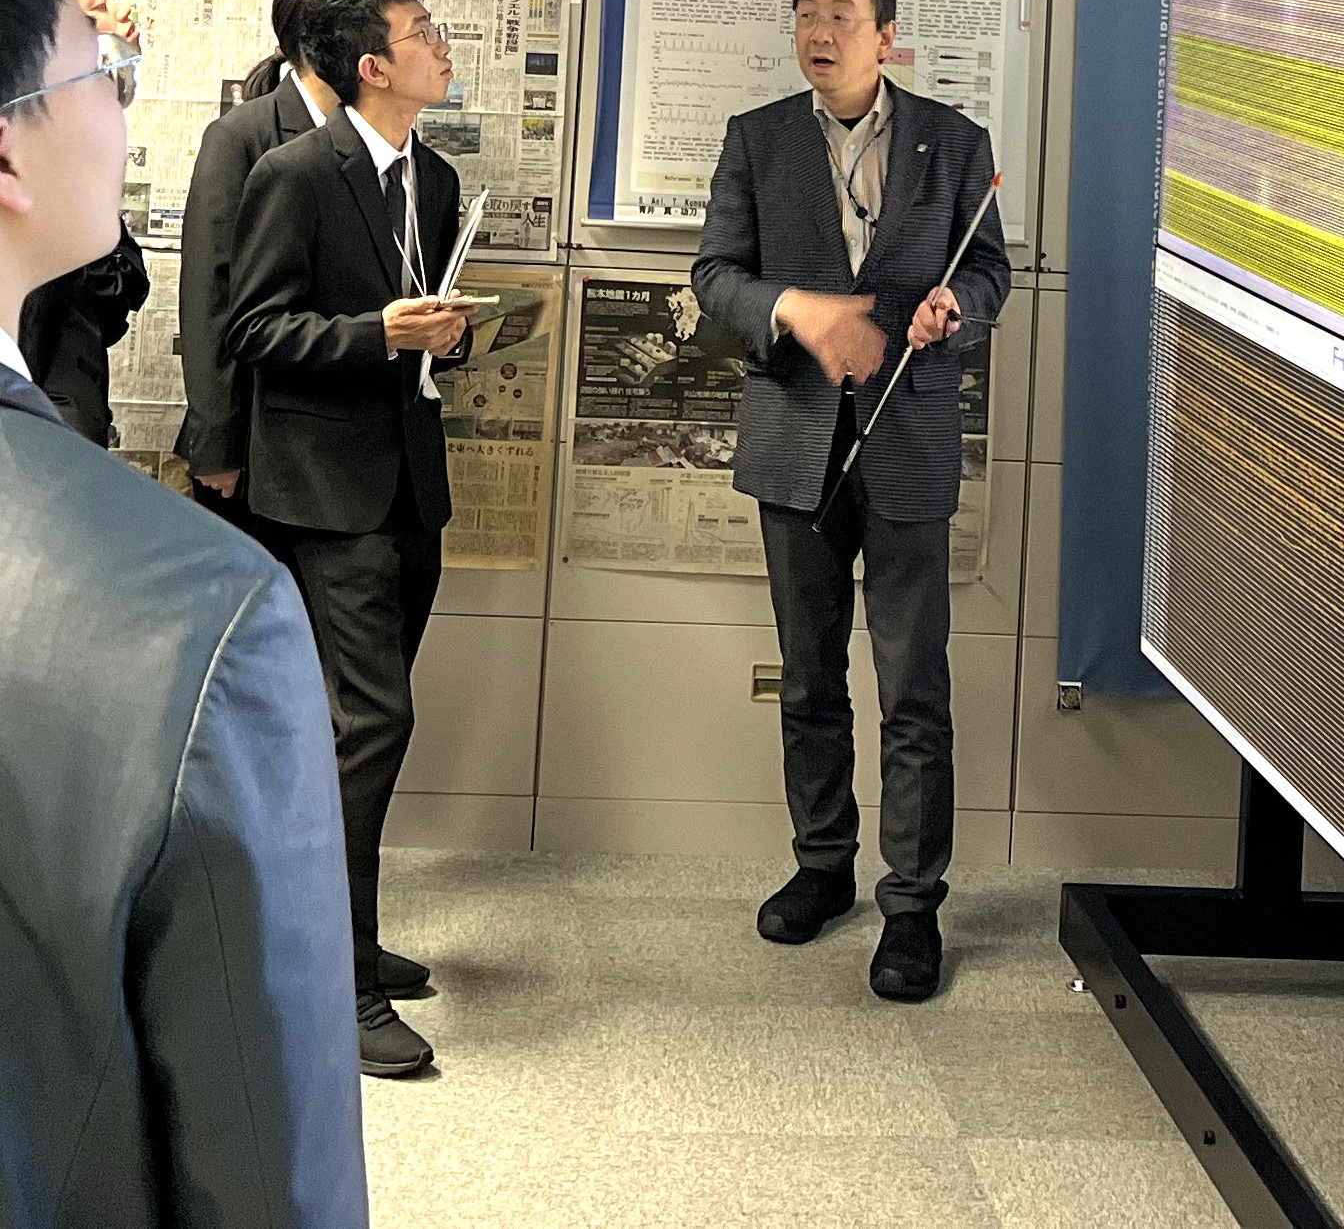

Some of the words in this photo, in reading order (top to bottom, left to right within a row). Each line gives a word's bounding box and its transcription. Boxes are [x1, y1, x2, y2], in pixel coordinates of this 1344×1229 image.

[522, 213, 546, 229] 人生
[447, 443, 535, 458] 北東へ大きくずれる
